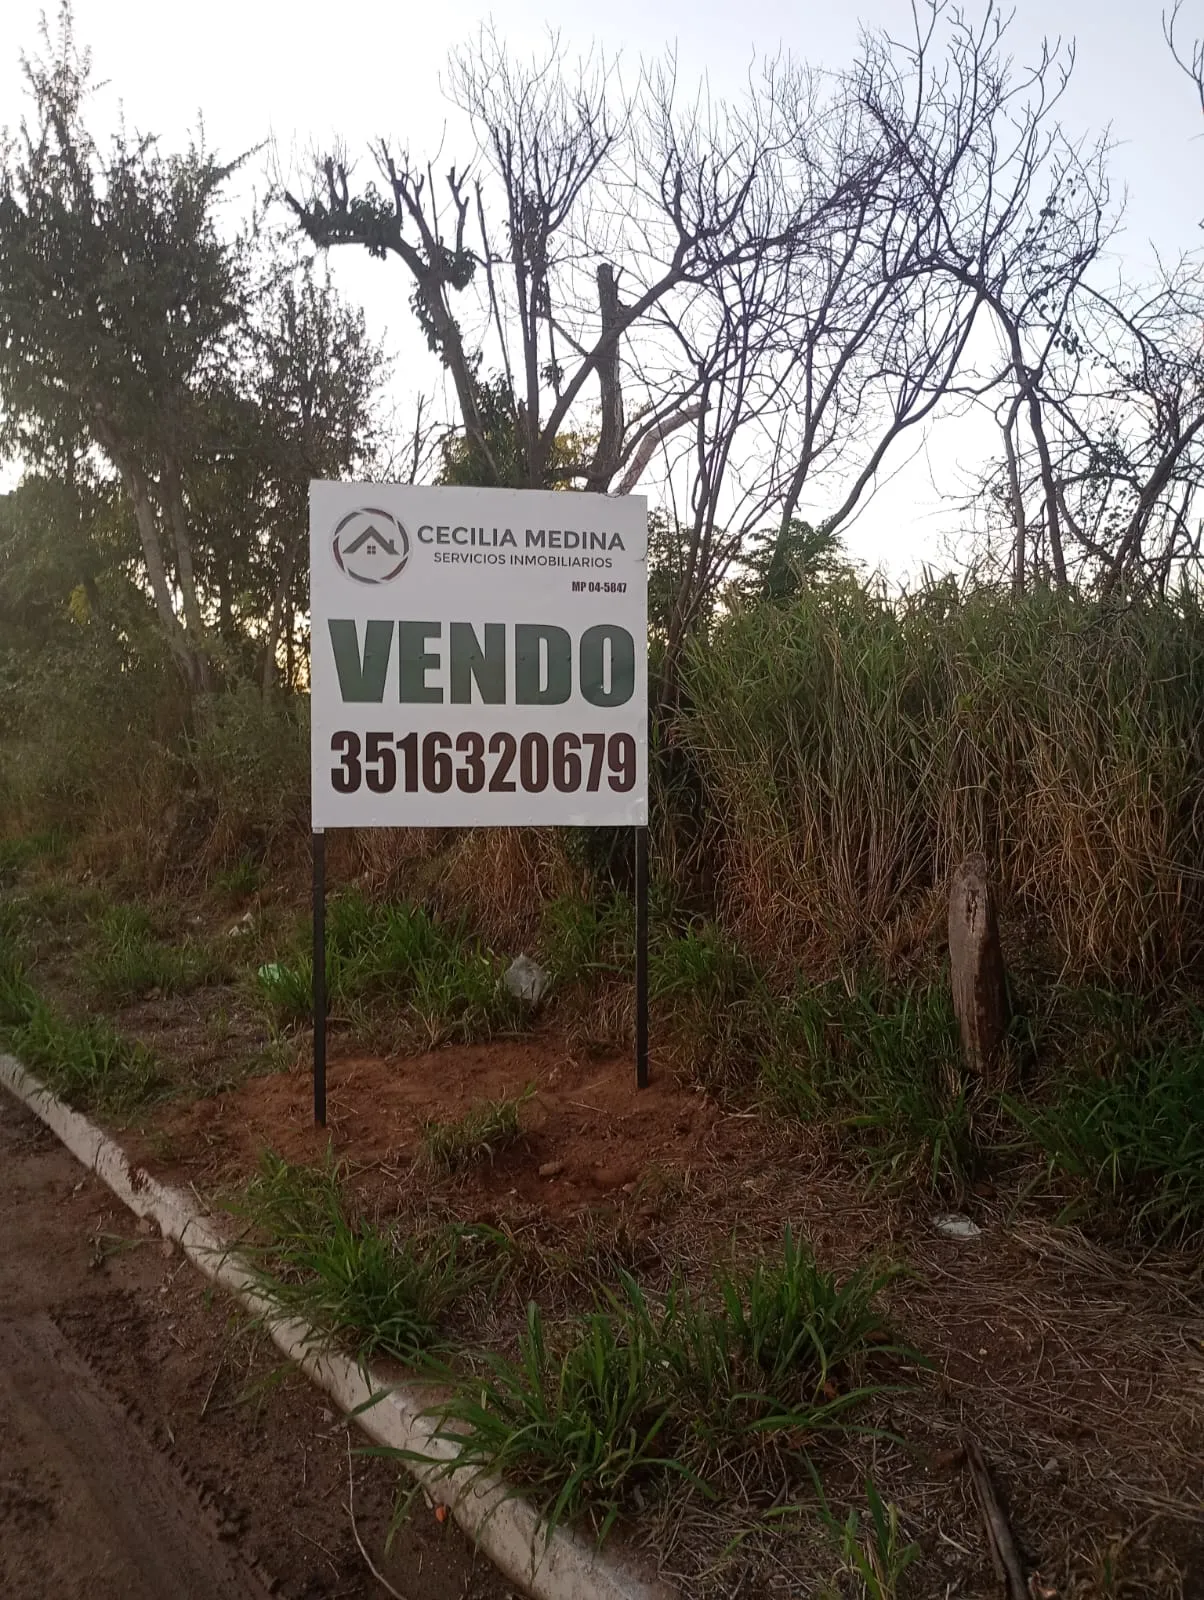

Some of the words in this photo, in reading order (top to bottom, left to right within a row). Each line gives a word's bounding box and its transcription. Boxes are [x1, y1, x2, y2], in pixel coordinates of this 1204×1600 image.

[417, 525, 518, 548] CECILIA
[525, 529, 626, 551] MEDINA
[433, 552, 506, 565] SERVICIOS
[510, 555, 613, 568] INMOBILIARIOS
[572, 581, 586, 593] MP
[588, 581, 627, 594] 04-5847
[327, 619, 635, 707] VENDO
[330, 730, 636, 794] 3516320679
